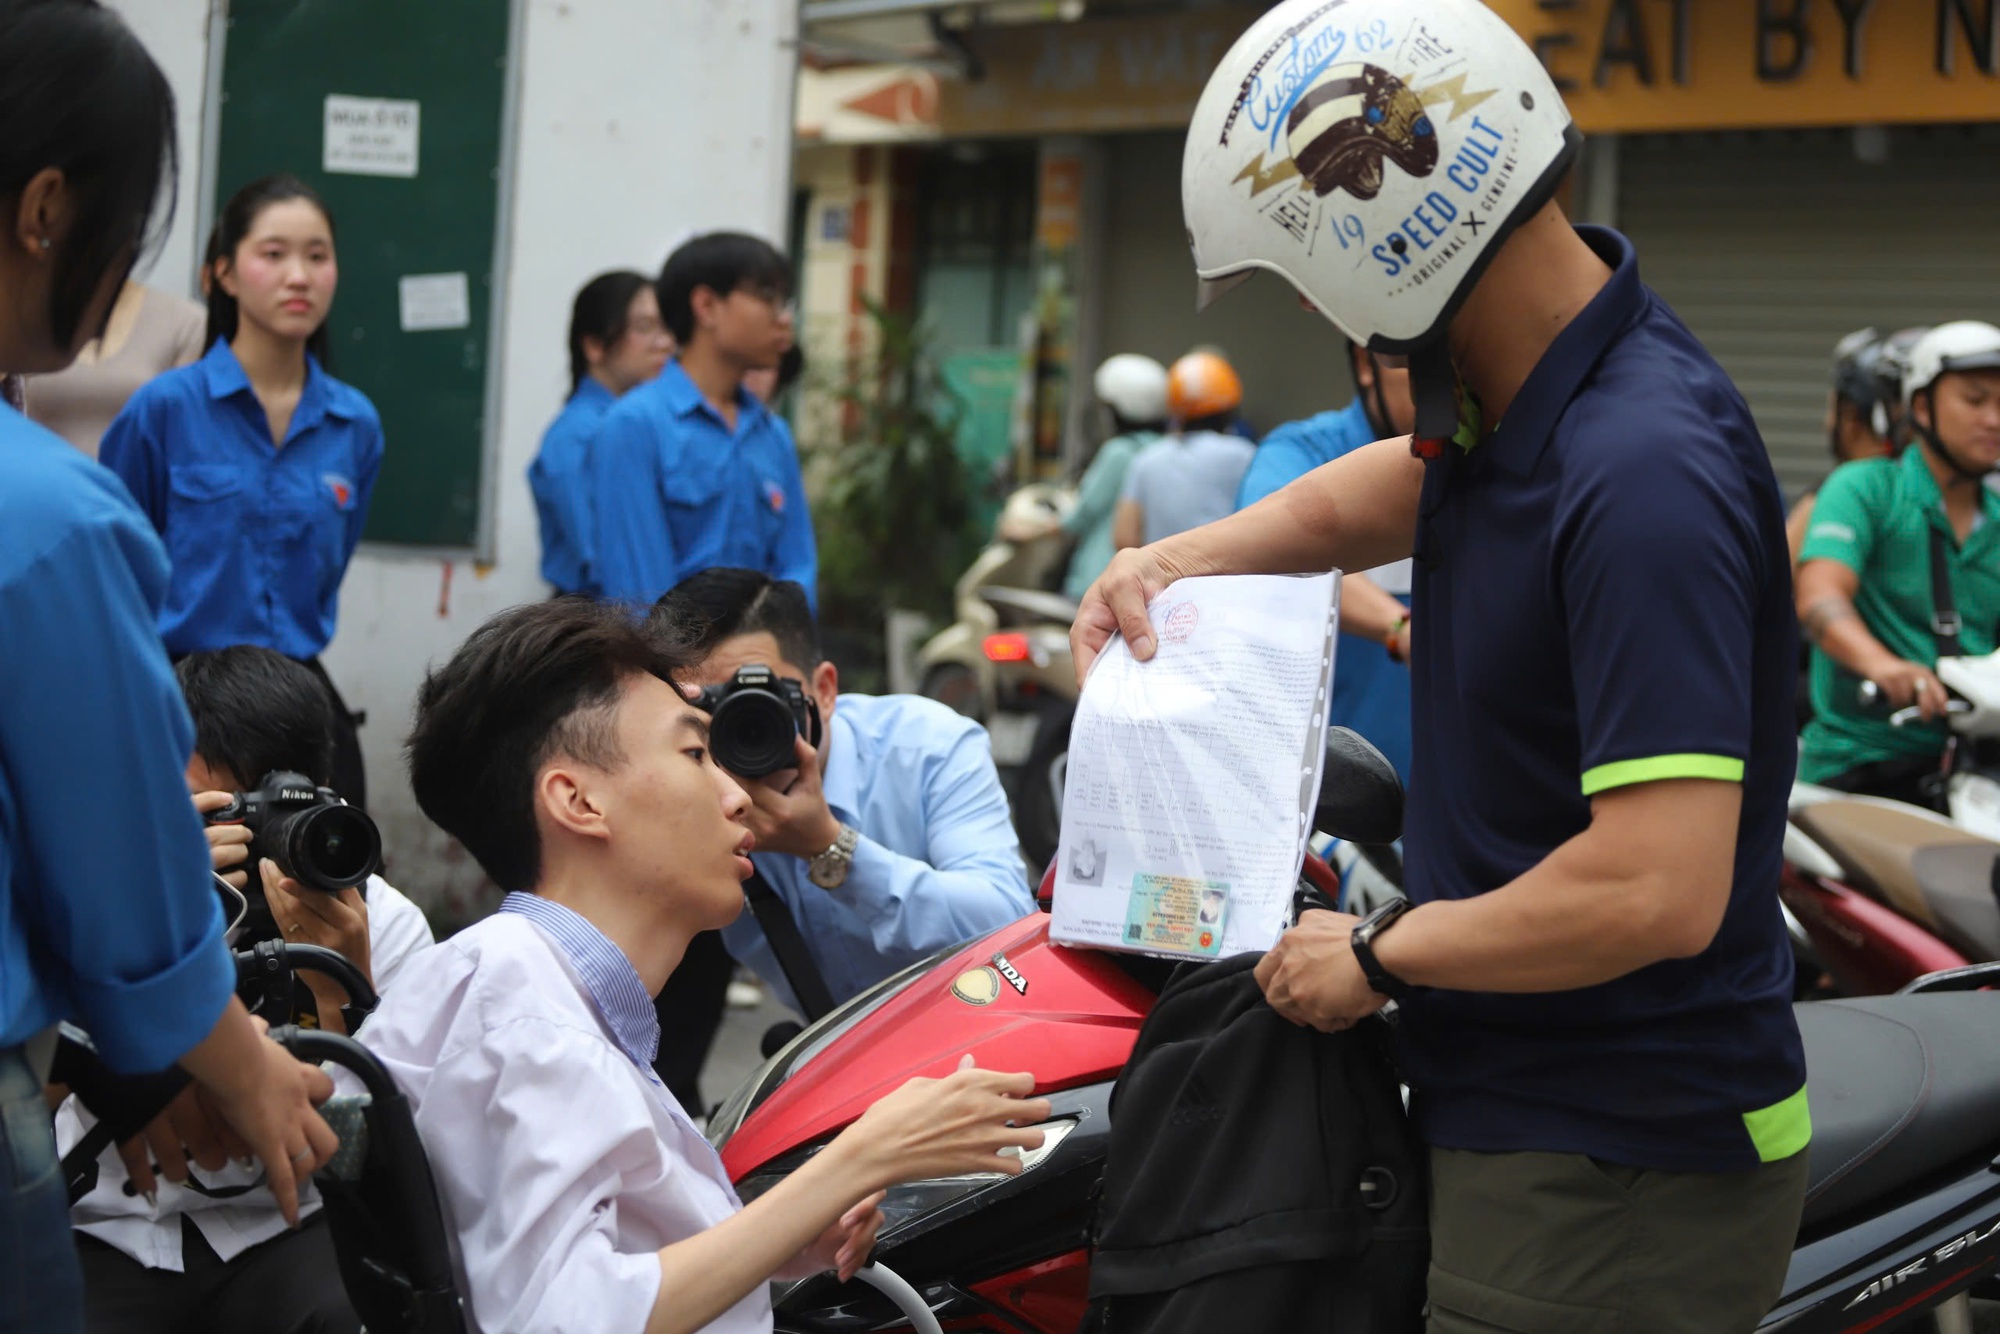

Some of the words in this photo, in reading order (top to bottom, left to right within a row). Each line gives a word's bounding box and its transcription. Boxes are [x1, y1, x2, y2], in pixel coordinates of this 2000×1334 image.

[1355, 19, 1394, 53] 62
[1408, 26, 1453, 67] FIRE
[1756, 0, 1873, 83] BY
[1241, 24, 1346, 142] Custom
[1270, 195, 1311, 243] HELL
[1372, 191, 1458, 276] SPEED
[1447, 116, 1503, 193] CULT
[1412, 236, 1467, 286] ORIGINAL
[1461, 211, 1486, 236] X
[1481, 155, 1517, 212] GENUINE
[1331, 213, 1365, 250] 19
[282, 788, 314, 800] Nikon
[1842, 1257, 1928, 1311] AIR
